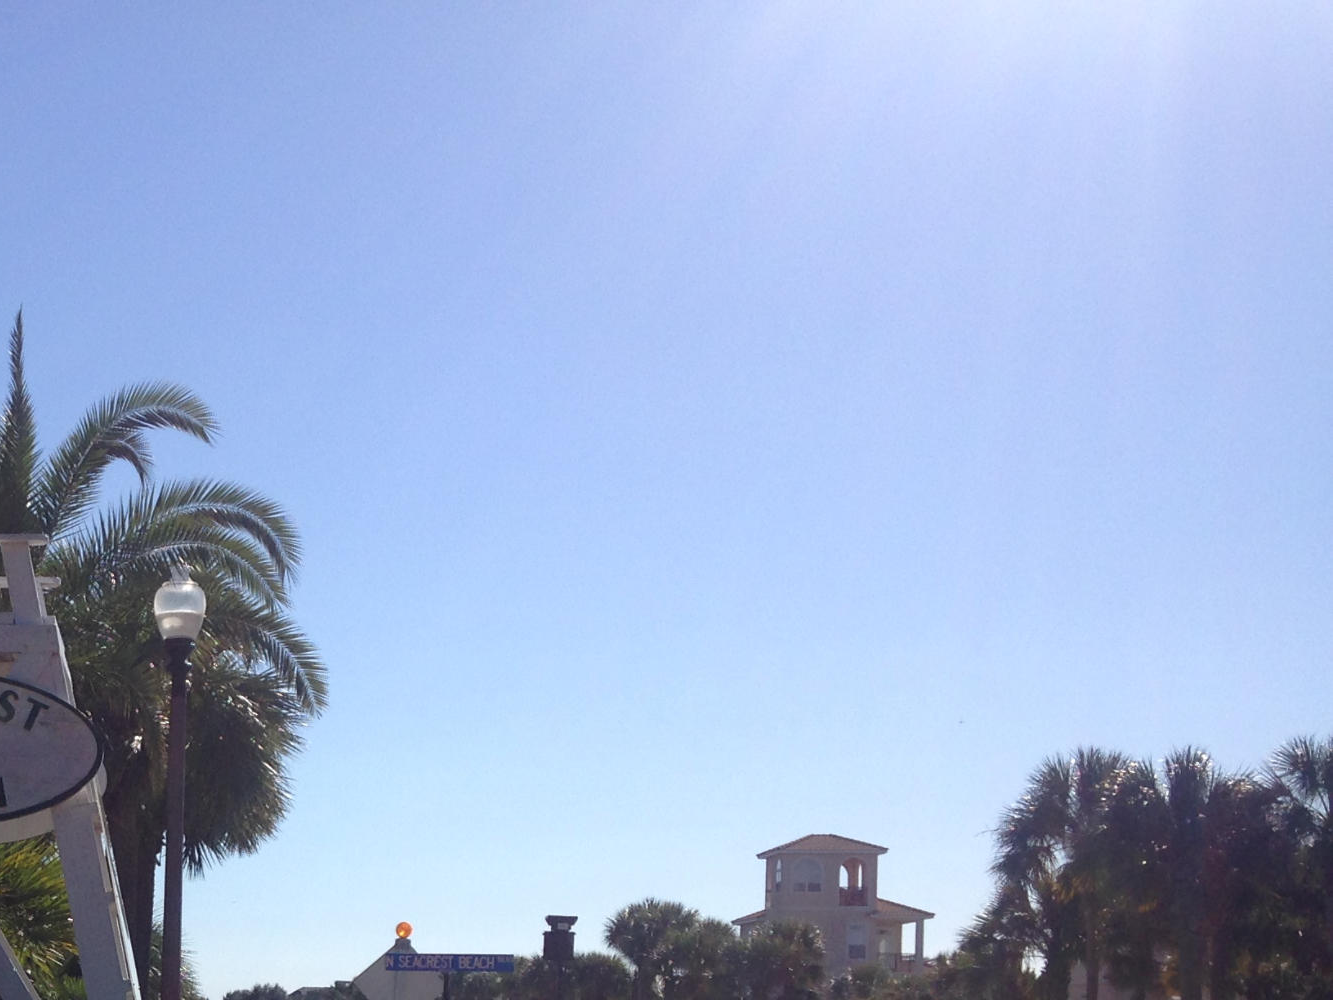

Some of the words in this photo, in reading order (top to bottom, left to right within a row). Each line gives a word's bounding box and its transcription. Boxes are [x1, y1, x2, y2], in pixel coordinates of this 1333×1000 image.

[386, 956, 394, 968] N
[398, 955, 453, 969] SEACREST
[458, 956, 495, 969] BEACH
